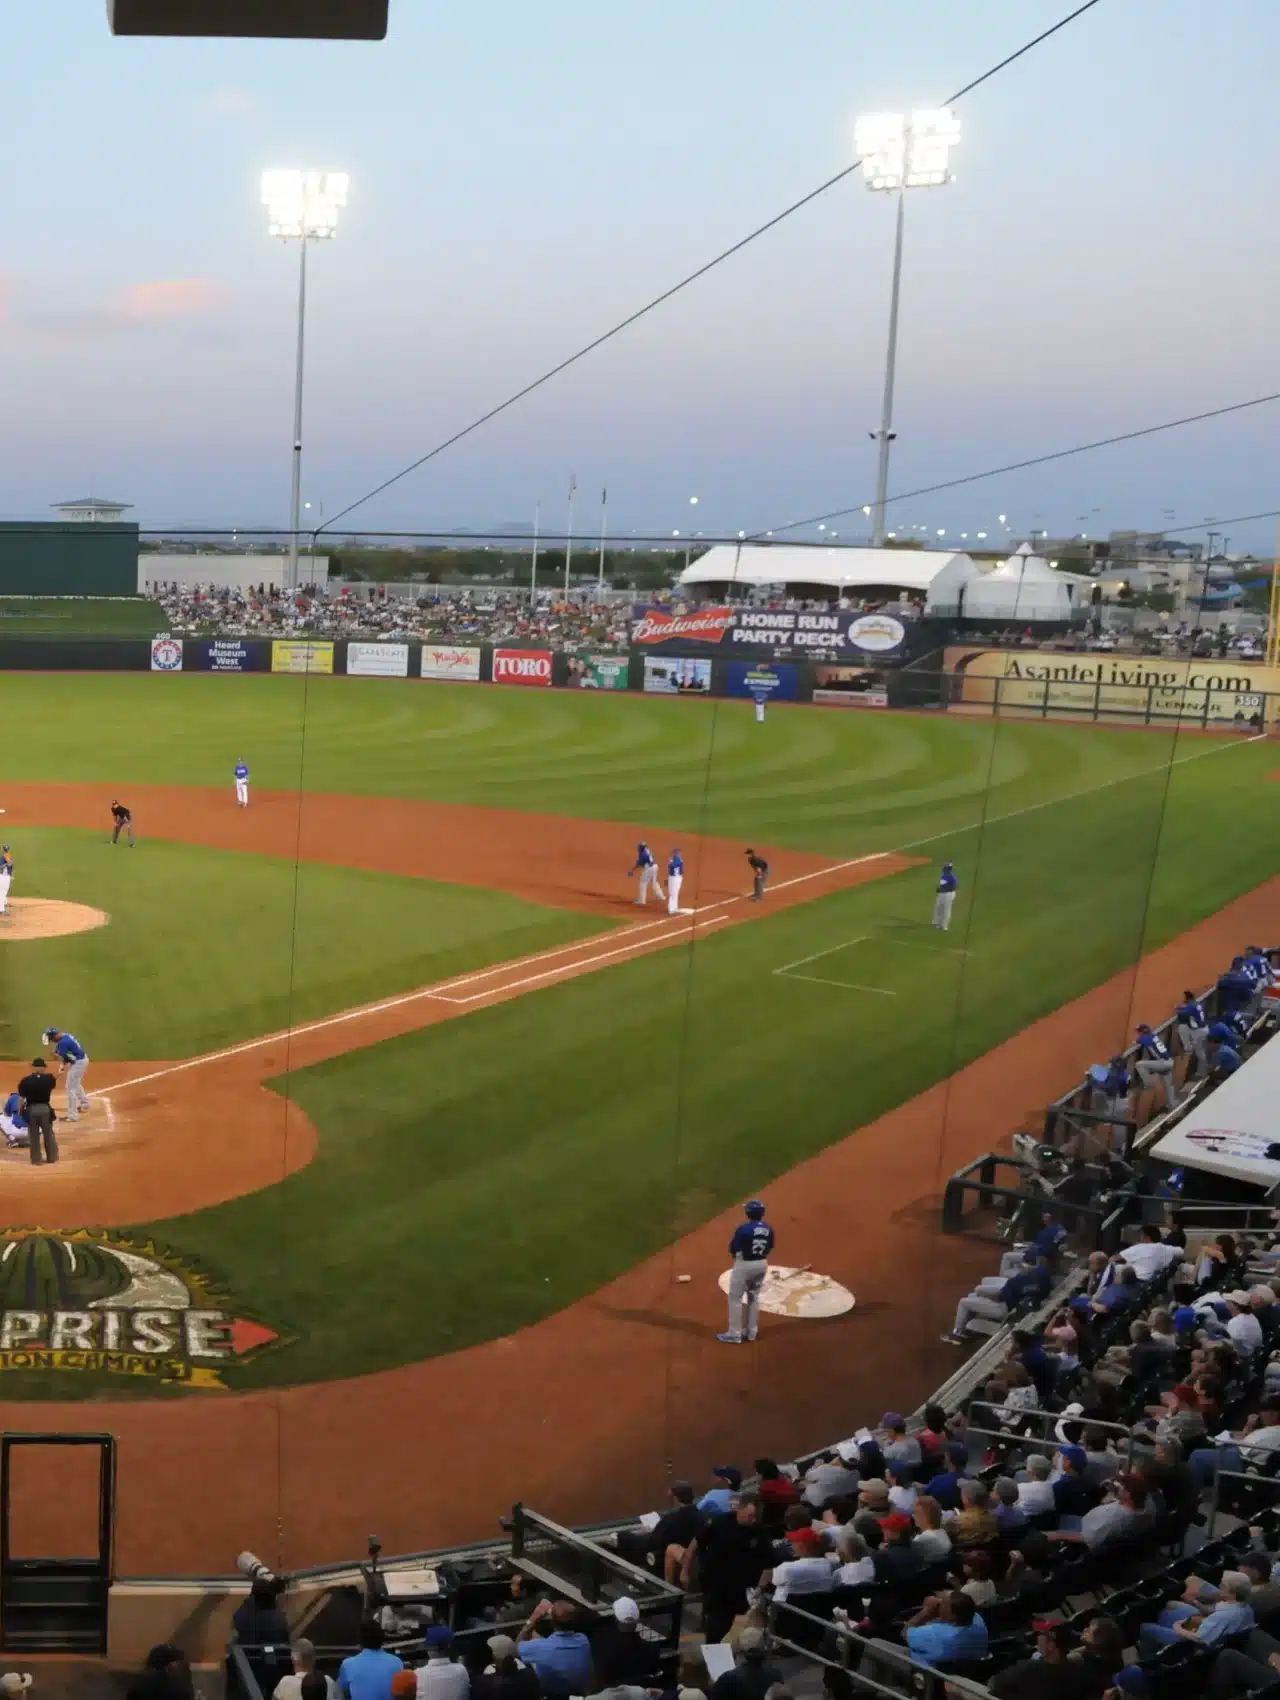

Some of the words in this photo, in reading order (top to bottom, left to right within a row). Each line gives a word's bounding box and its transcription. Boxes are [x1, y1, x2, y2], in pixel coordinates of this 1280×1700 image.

[632, 614, 736, 640] Budweiser
[741, 614, 793, 629] HOME
[798, 616, 839, 630] RUN
[214, 640, 241, 649] Heard
[732, 630, 791, 646] PARTY
[793, 632, 846, 647] DECK
[208, 649, 247, 657] Museum
[216, 657, 239, 665] West
[496, 657, 551, 677] TORO
[60, 1350, 186, 1380] CAMPUS
